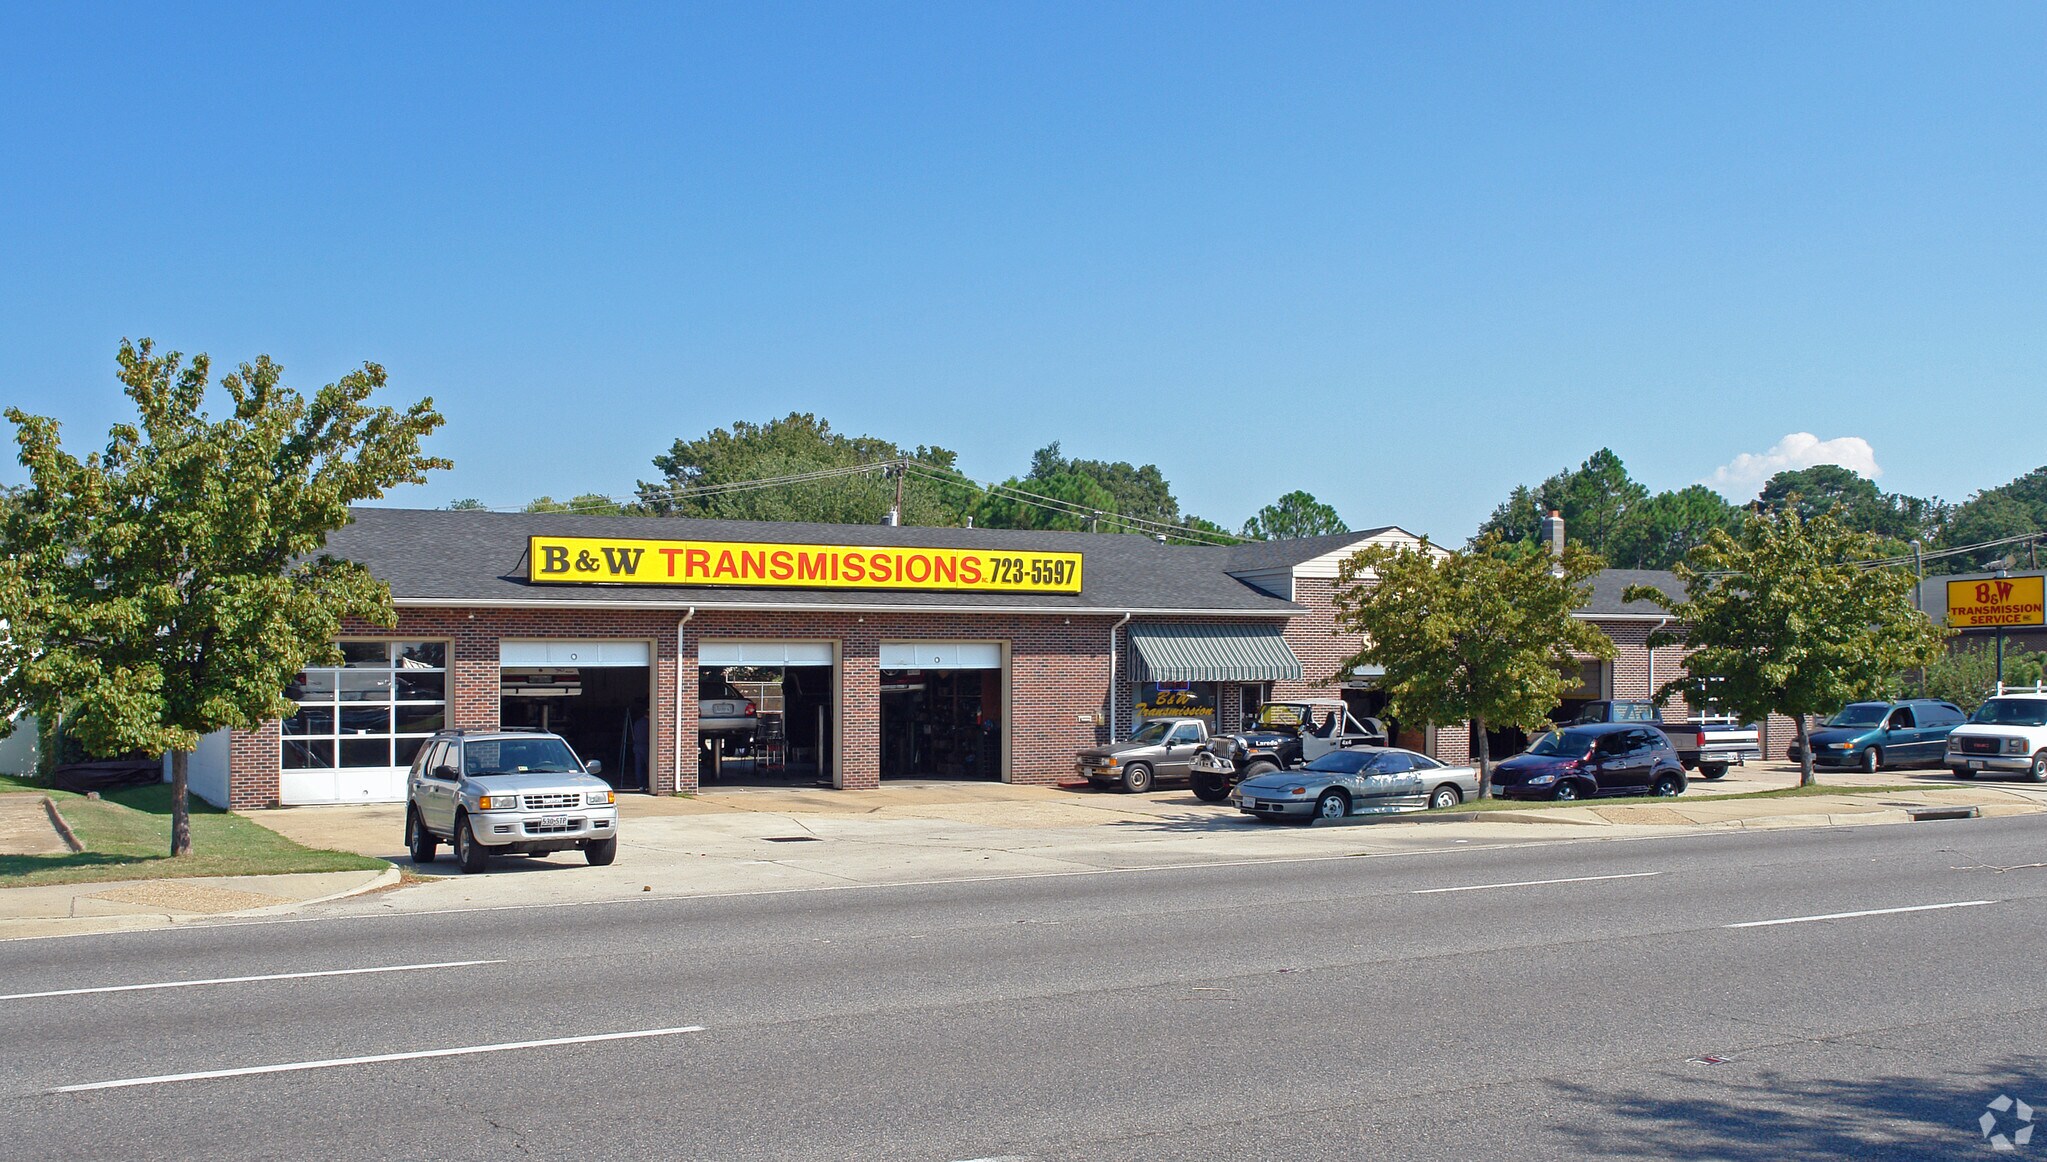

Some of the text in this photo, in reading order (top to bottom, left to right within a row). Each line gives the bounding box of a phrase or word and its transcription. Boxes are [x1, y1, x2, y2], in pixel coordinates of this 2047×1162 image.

[540, 546, 645, 575] B&W
[659, 548, 982, 584] TRANSMISSIONS
[990, 557, 1076, 584] 723-5597
[1975, 581, 2014, 604] B&W
[1951, 603, 2042, 615] TRANSMISSION
[1970, 614, 2021, 624] SERVICE
[1156, 690, 1196, 705] B&W
[1135, 702, 1215, 717] Transmission
[1255, 739, 1278, 747] Laredo
